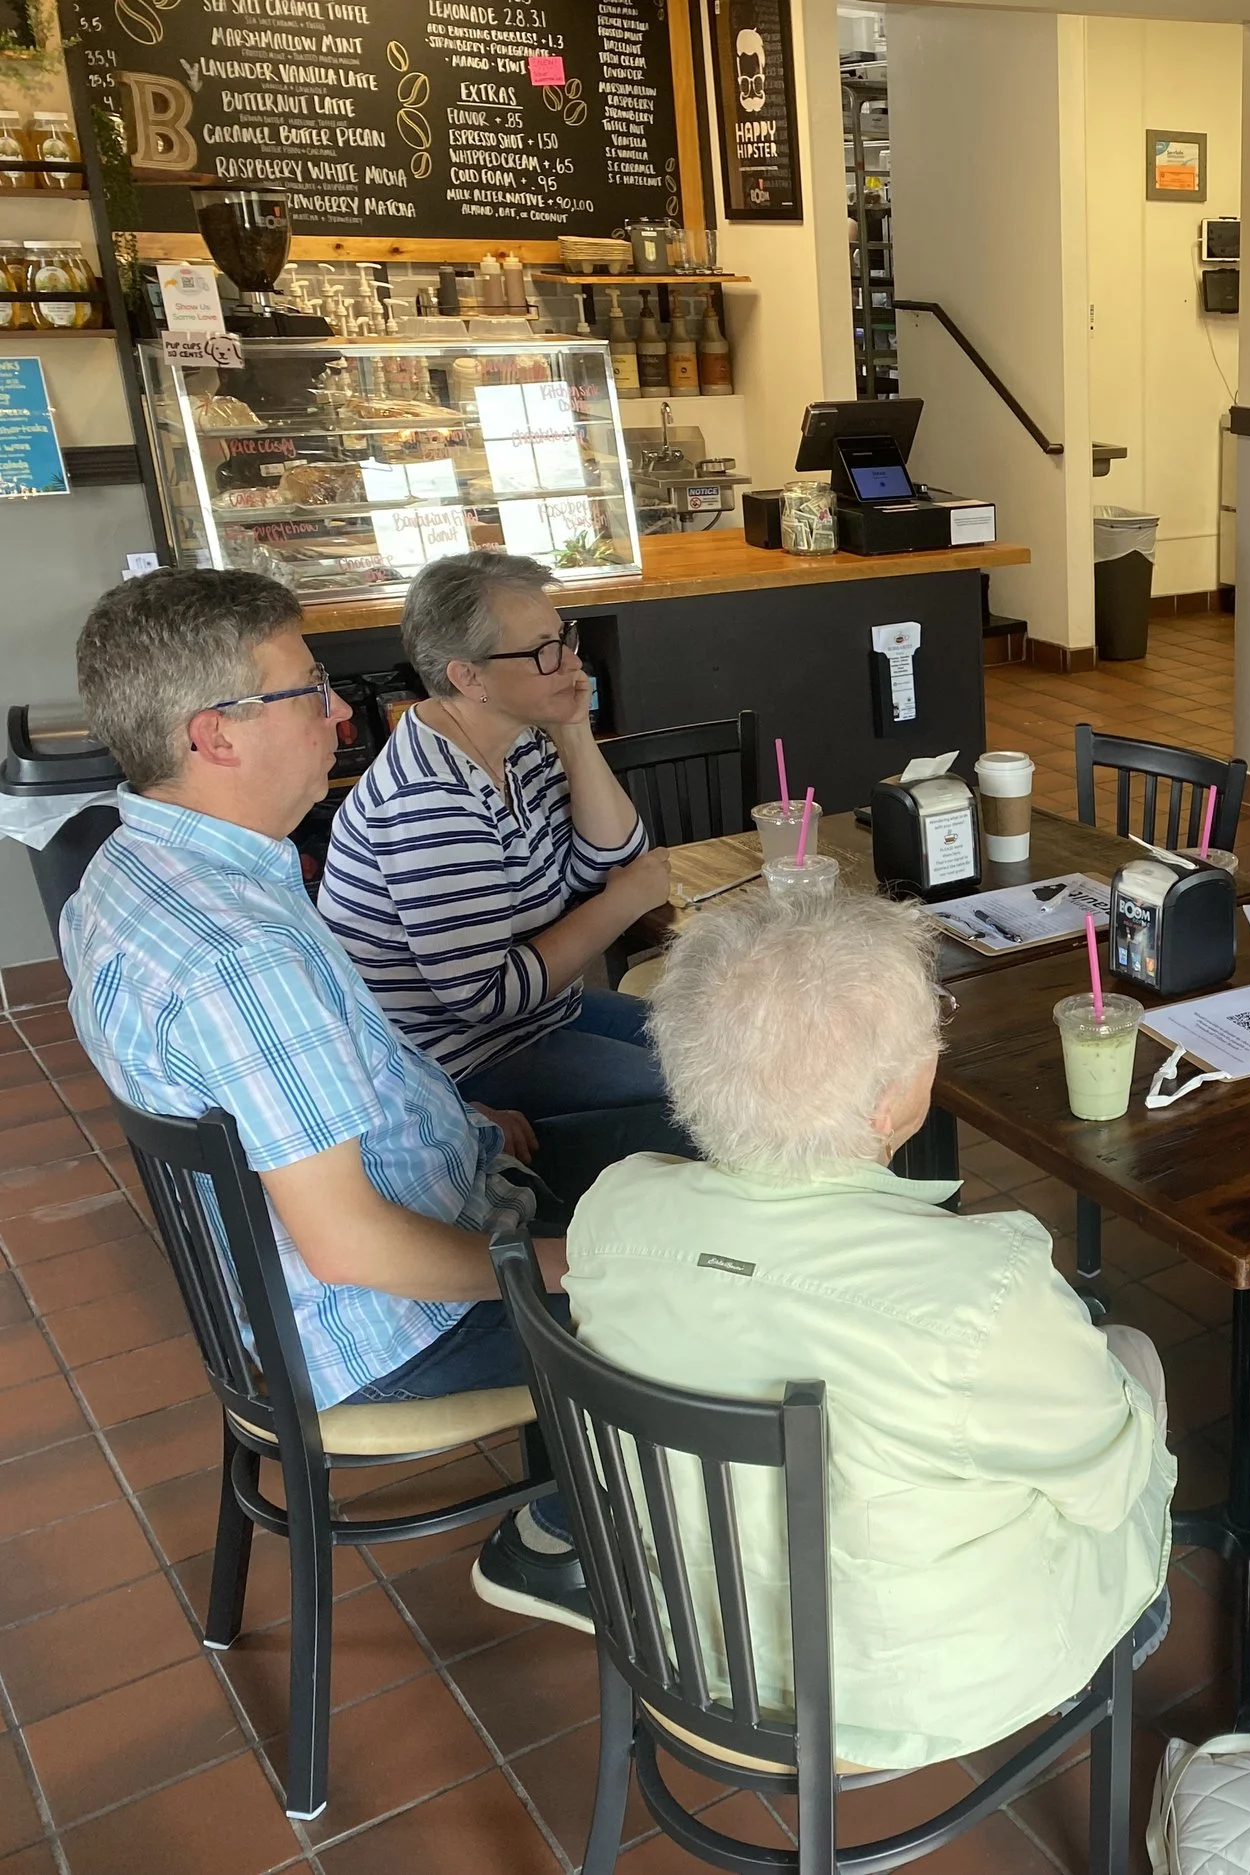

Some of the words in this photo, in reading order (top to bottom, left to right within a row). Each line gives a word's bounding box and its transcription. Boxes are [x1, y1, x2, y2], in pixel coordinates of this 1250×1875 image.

[266, 0, 324, 20] CARAMEL
[327, 2, 370, 24] TOFFEE
[429, 0, 498, 25] LEMONADE
[211, 27, 316, 51] MARSHMALLOW
[322, 34, 362, 54] MINT
[603, 37, 642, 55] HAZELNUT
[497, 57, 528, 75] KIWI
[620, 55, 647, 69] CREAM
[200, 57, 279, 81] LAVENDER
[279, 64, 337, 85] VANILLA
[339, 69, 378, 91] LATTE
[603, 65, 645, 80] LAVENDER
[460, 82, 517, 106] EXTRAS
[607, 94, 654, 111] RASPBERRY
[222, 91, 308, 114] BUTTERNUT
[314, 96, 356, 118] LATTE
[118, 70, 198, 171] B
[447, 107, 490, 127] FLAVOR
[504, 112, 523, 129] .85
[203, 123, 275, 145] CARAMEL
[279, 125, 334, 146] BUTTER
[337, 127, 386, 148] PECAN
[449, 129, 497, 147] ESPRESSO
[499, 133, 525, 149] SHOT
[611, 134, 648, 148] VANILLA
[735, 120, 777, 143] HAPPY
[736, 142, 778, 159] HIPSTER
[449, 148, 500, 167] WHIPPED
[501, 153, 542, 173] CREAM
[552, 158, 574, 174] .65
[620, 162, 656, 175] CARAMEL
[215, 156, 303, 182] RASPBERRY
[308, 161, 359, 183] WHITE
[365, 166, 408, 188] MOCHA
[450, 167, 479, 185] COLD
[481, 169, 517, 188] FOAM
[623, 175, 662, 187] HAZELNUT
[287, 193, 359, 215] RAWBERRY
[365, 198, 416, 218] MATCHA
[446, 189, 472, 201] MILK
[473, 189, 545, 208] ALTERNATIVE
[530, 210, 569, 224] COCONUT
[172, 313, 197, 321] Some
[175, 303, 198, 311] Show
[165, 341, 180, 350] PUP
[182, 342, 202, 351] CUPS
[180, 350, 204, 359] CENTS
[1119, 899, 1151, 922] BOOM
